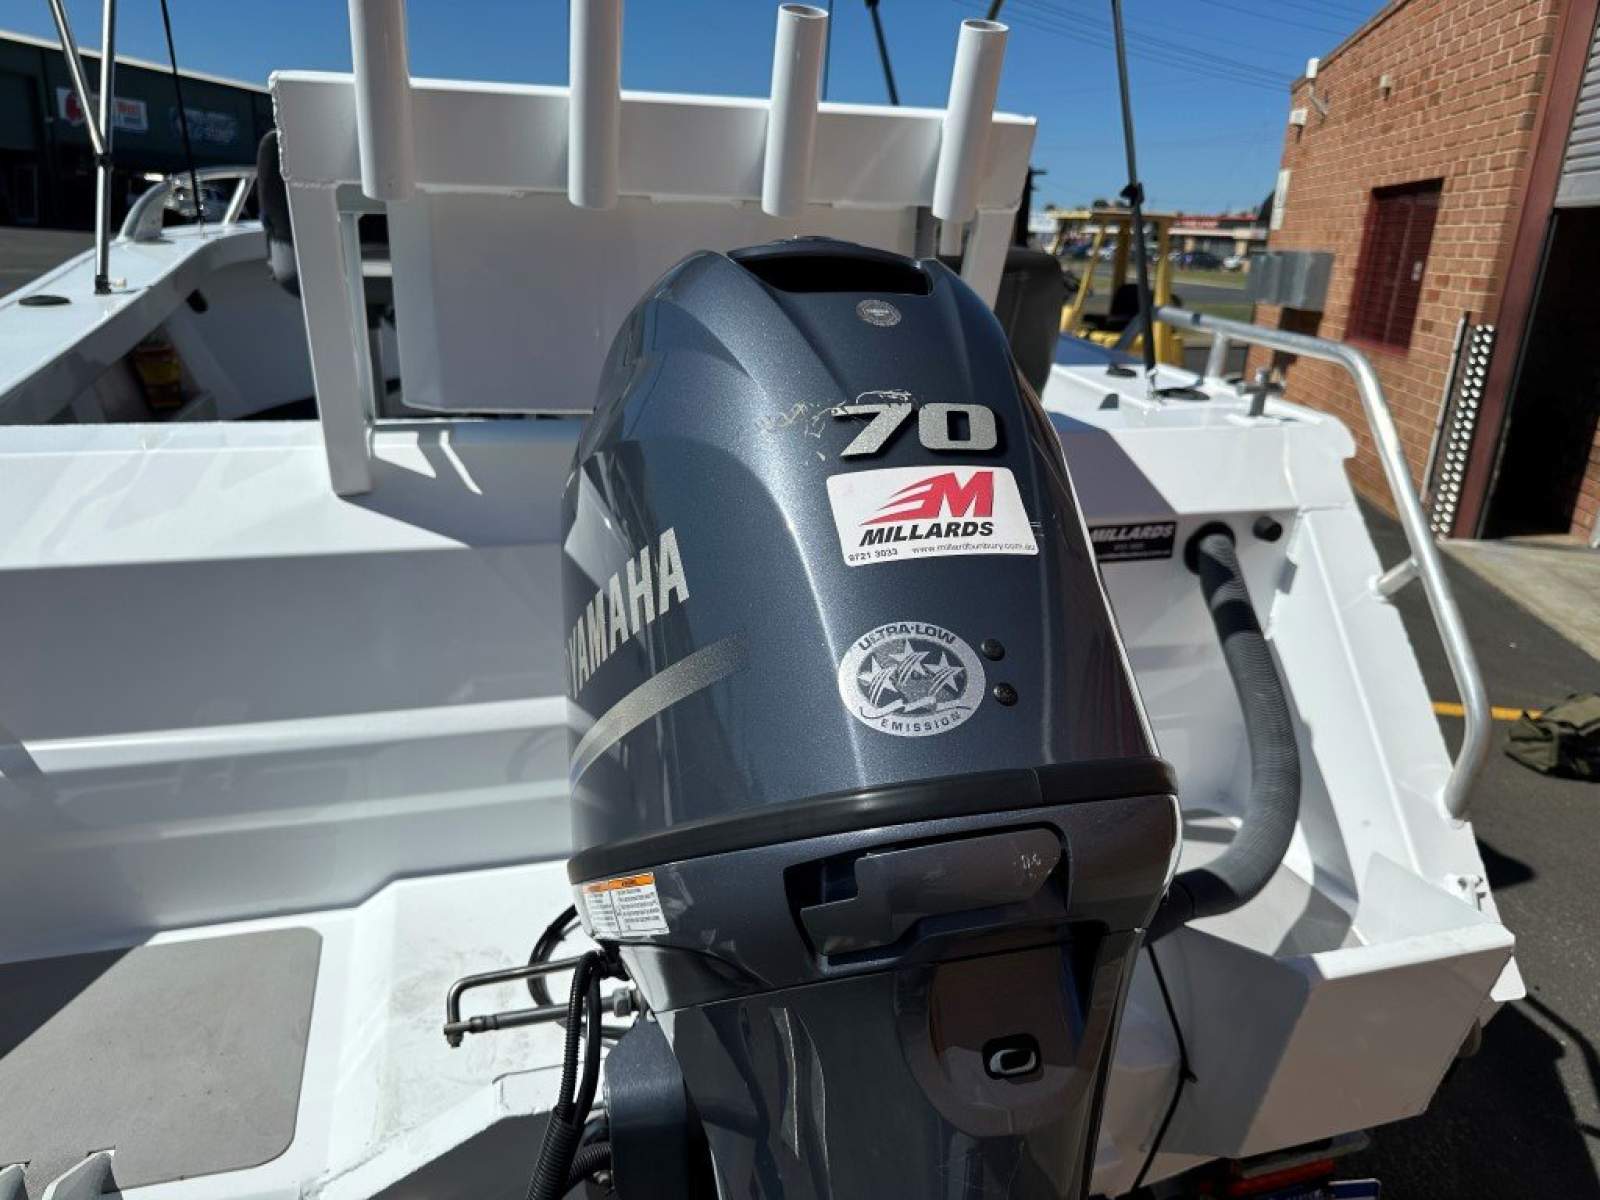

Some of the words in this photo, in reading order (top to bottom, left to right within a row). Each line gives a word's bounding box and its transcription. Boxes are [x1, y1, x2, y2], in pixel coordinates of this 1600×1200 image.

[831, 402, 998, 457] 70
[858, 521, 995, 547] MILLARDS
[567, 526, 690, 699] YAMAHA
[880, 710, 963, 733] EMISSION
